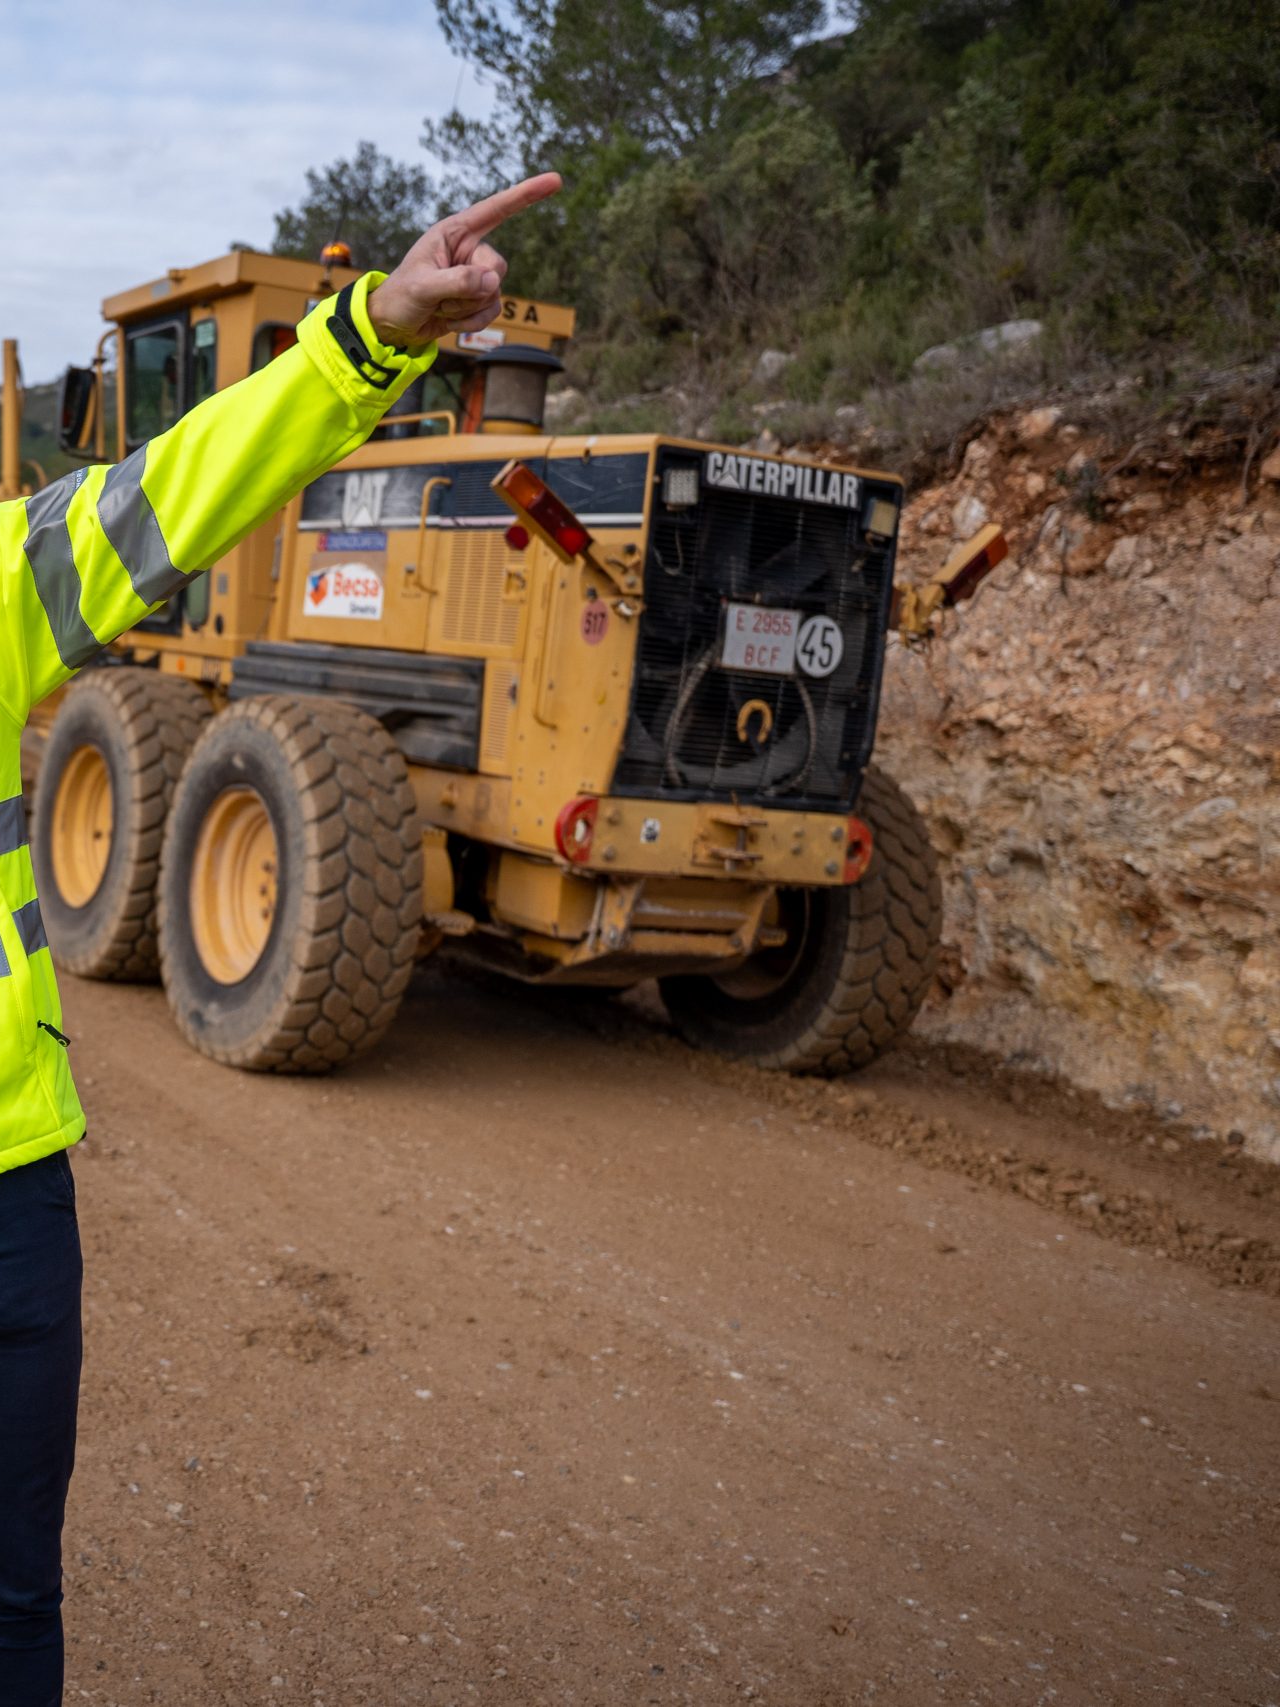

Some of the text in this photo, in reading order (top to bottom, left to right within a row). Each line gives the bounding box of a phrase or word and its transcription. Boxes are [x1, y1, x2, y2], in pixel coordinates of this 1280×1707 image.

[706, 451, 860, 509] CATERPILLAR
[342, 472, 390, 527] CAT
[332, 570, 380, 598] Becsa
[584, 611, 607, 636] 517
[735, 608, 792, 637] E 2955
[743, 642, 781, 667] BCF
[800, 623, 835, 669] 45
